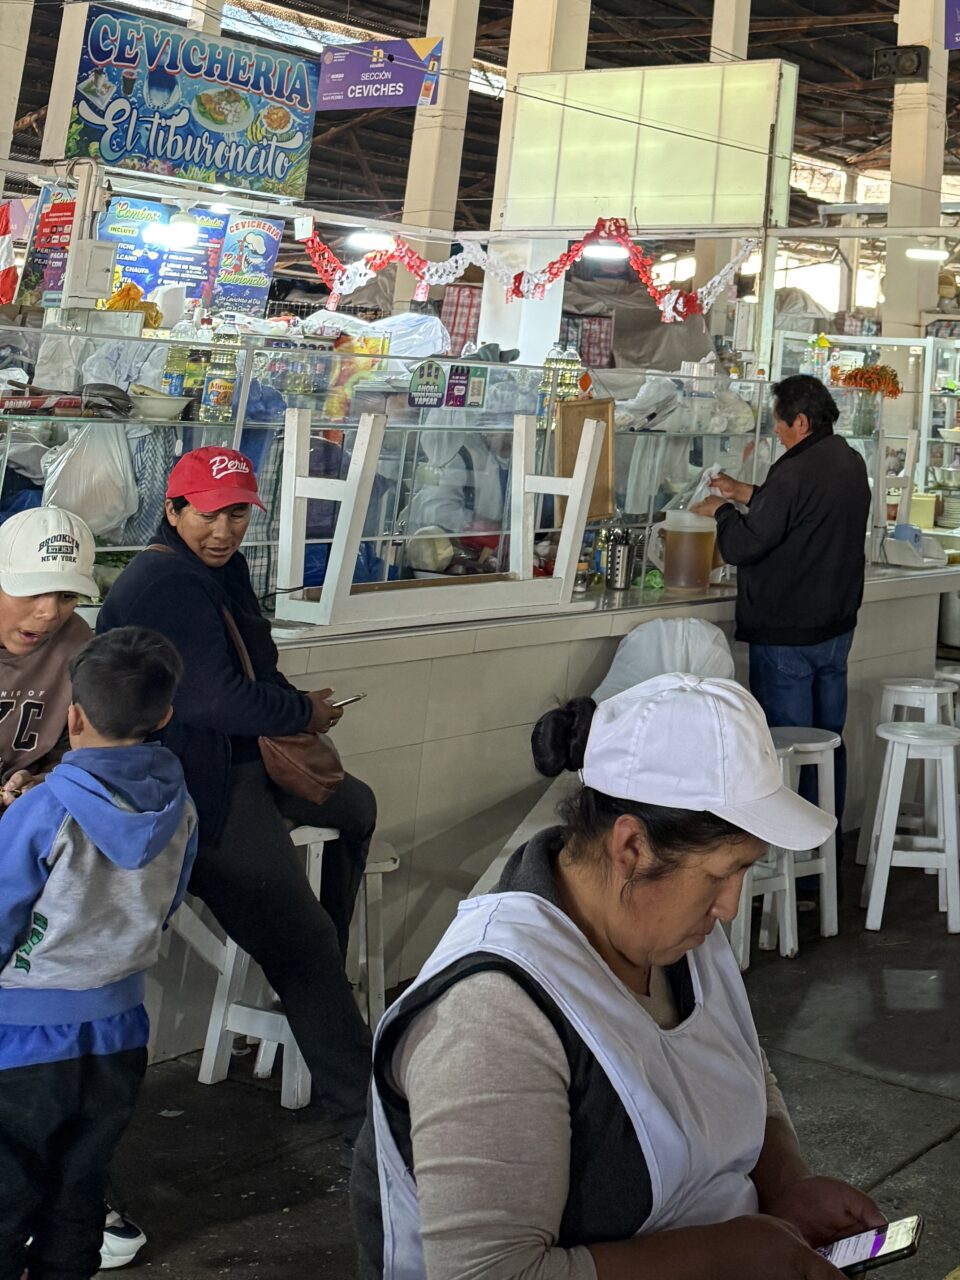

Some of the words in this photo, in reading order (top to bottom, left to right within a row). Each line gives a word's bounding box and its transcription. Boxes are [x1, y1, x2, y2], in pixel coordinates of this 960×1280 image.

[88, 14, 312, 111] CEVICHERIA
[360, 70, 392, 81] SECCIÓN
[347, 82, 404, 98] CEVICHES
[78, 97, 138, 164] El
[229, 220, 281, 241] CEVICHERIA
[38, 534, 80, 553] BROOKLYN
[41, 554, 58, 562] NEW
[61, 554, 77, 563] YORK
